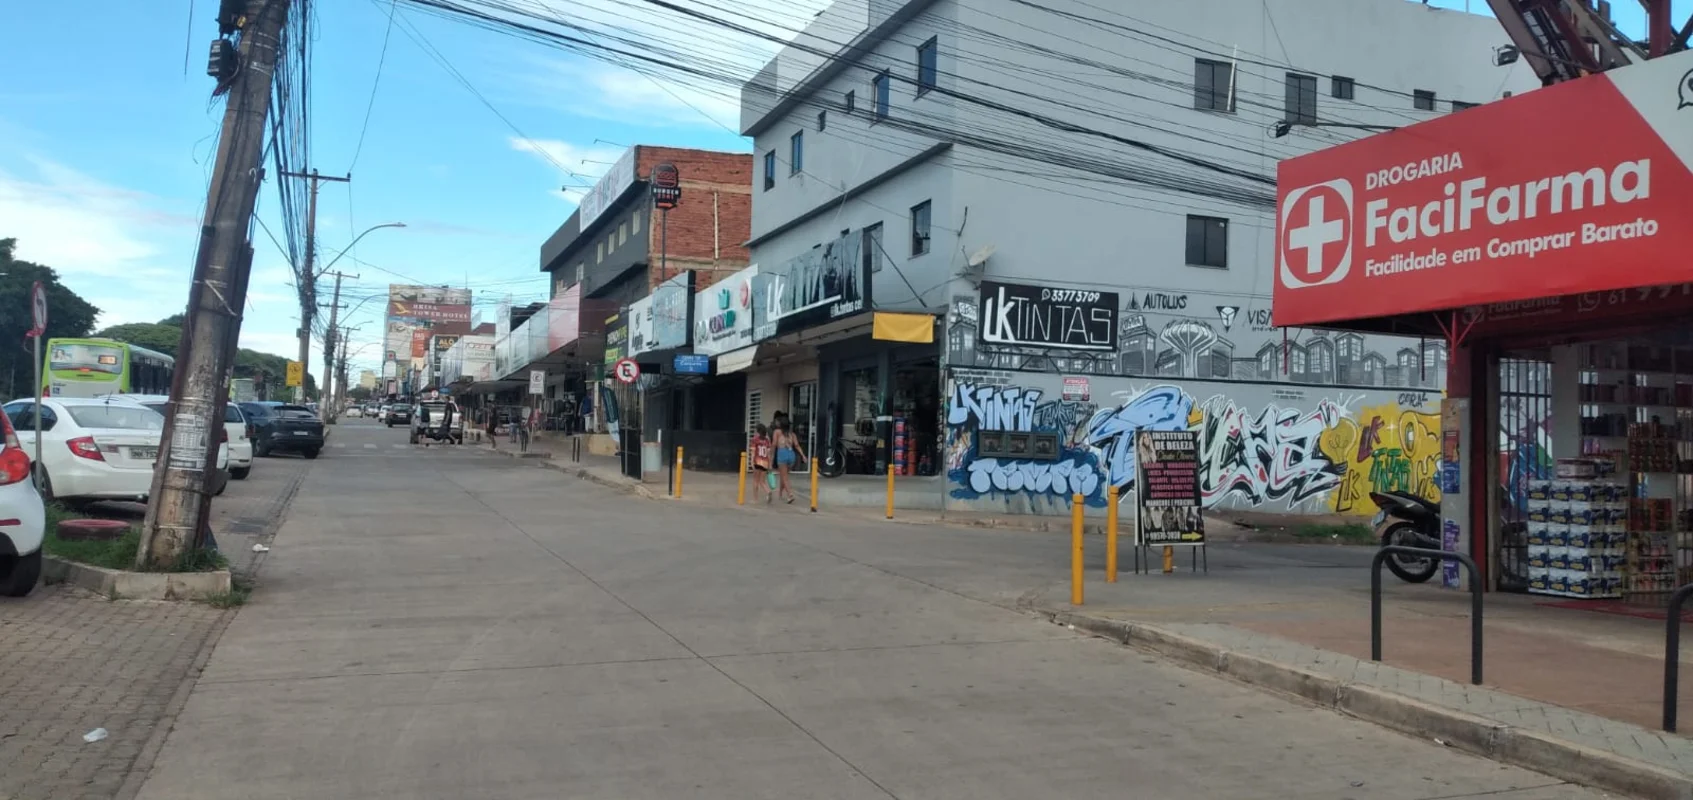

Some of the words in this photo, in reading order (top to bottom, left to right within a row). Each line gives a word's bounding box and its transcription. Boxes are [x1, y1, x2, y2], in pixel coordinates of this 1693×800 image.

[1365, 151, 1463, 190] DROGARIA
[1365, 158, 1651, 248] FaciFarma
[1365, 248, 1447, 277] Facilidade
[1452, 246, 1481, 264] em
[1487, 231, 1576, 258] Comprar
[1581, 217, 1658, 245] Barato
[441, 312, 468, 320] HOTEL
[1152, 432, 1193, 440] INSTITUTO
[1155, 441, 1165, 450] DE
[1166, 441, 1195, 450] BELEZA
